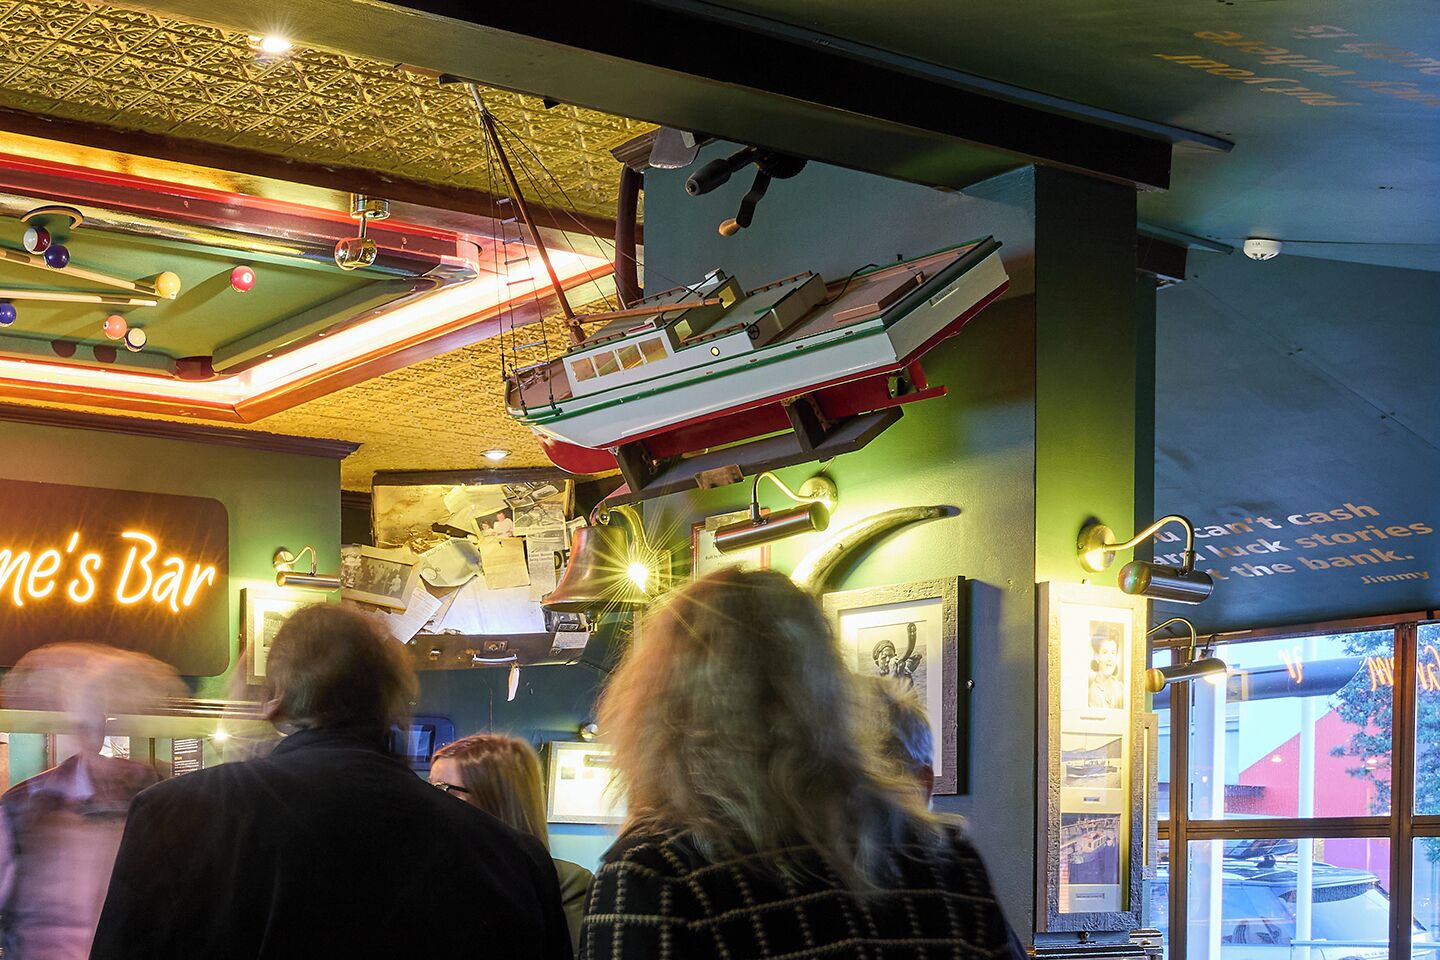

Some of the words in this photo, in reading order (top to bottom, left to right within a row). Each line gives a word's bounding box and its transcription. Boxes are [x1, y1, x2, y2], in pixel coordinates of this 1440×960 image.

[1194, 516, 1283, 539] can't
[1287, 502, 1380, 526] cash
[1205, 538, 1292, 559] luck
[1295, 521, 1434, 549] stories
[116, 532, 216, 612] Bar
[1230, 561, 1296, 578] the
[1297, 548, 1415, 571] bank.
[1360, 570, 1431, 586] Jimmy
